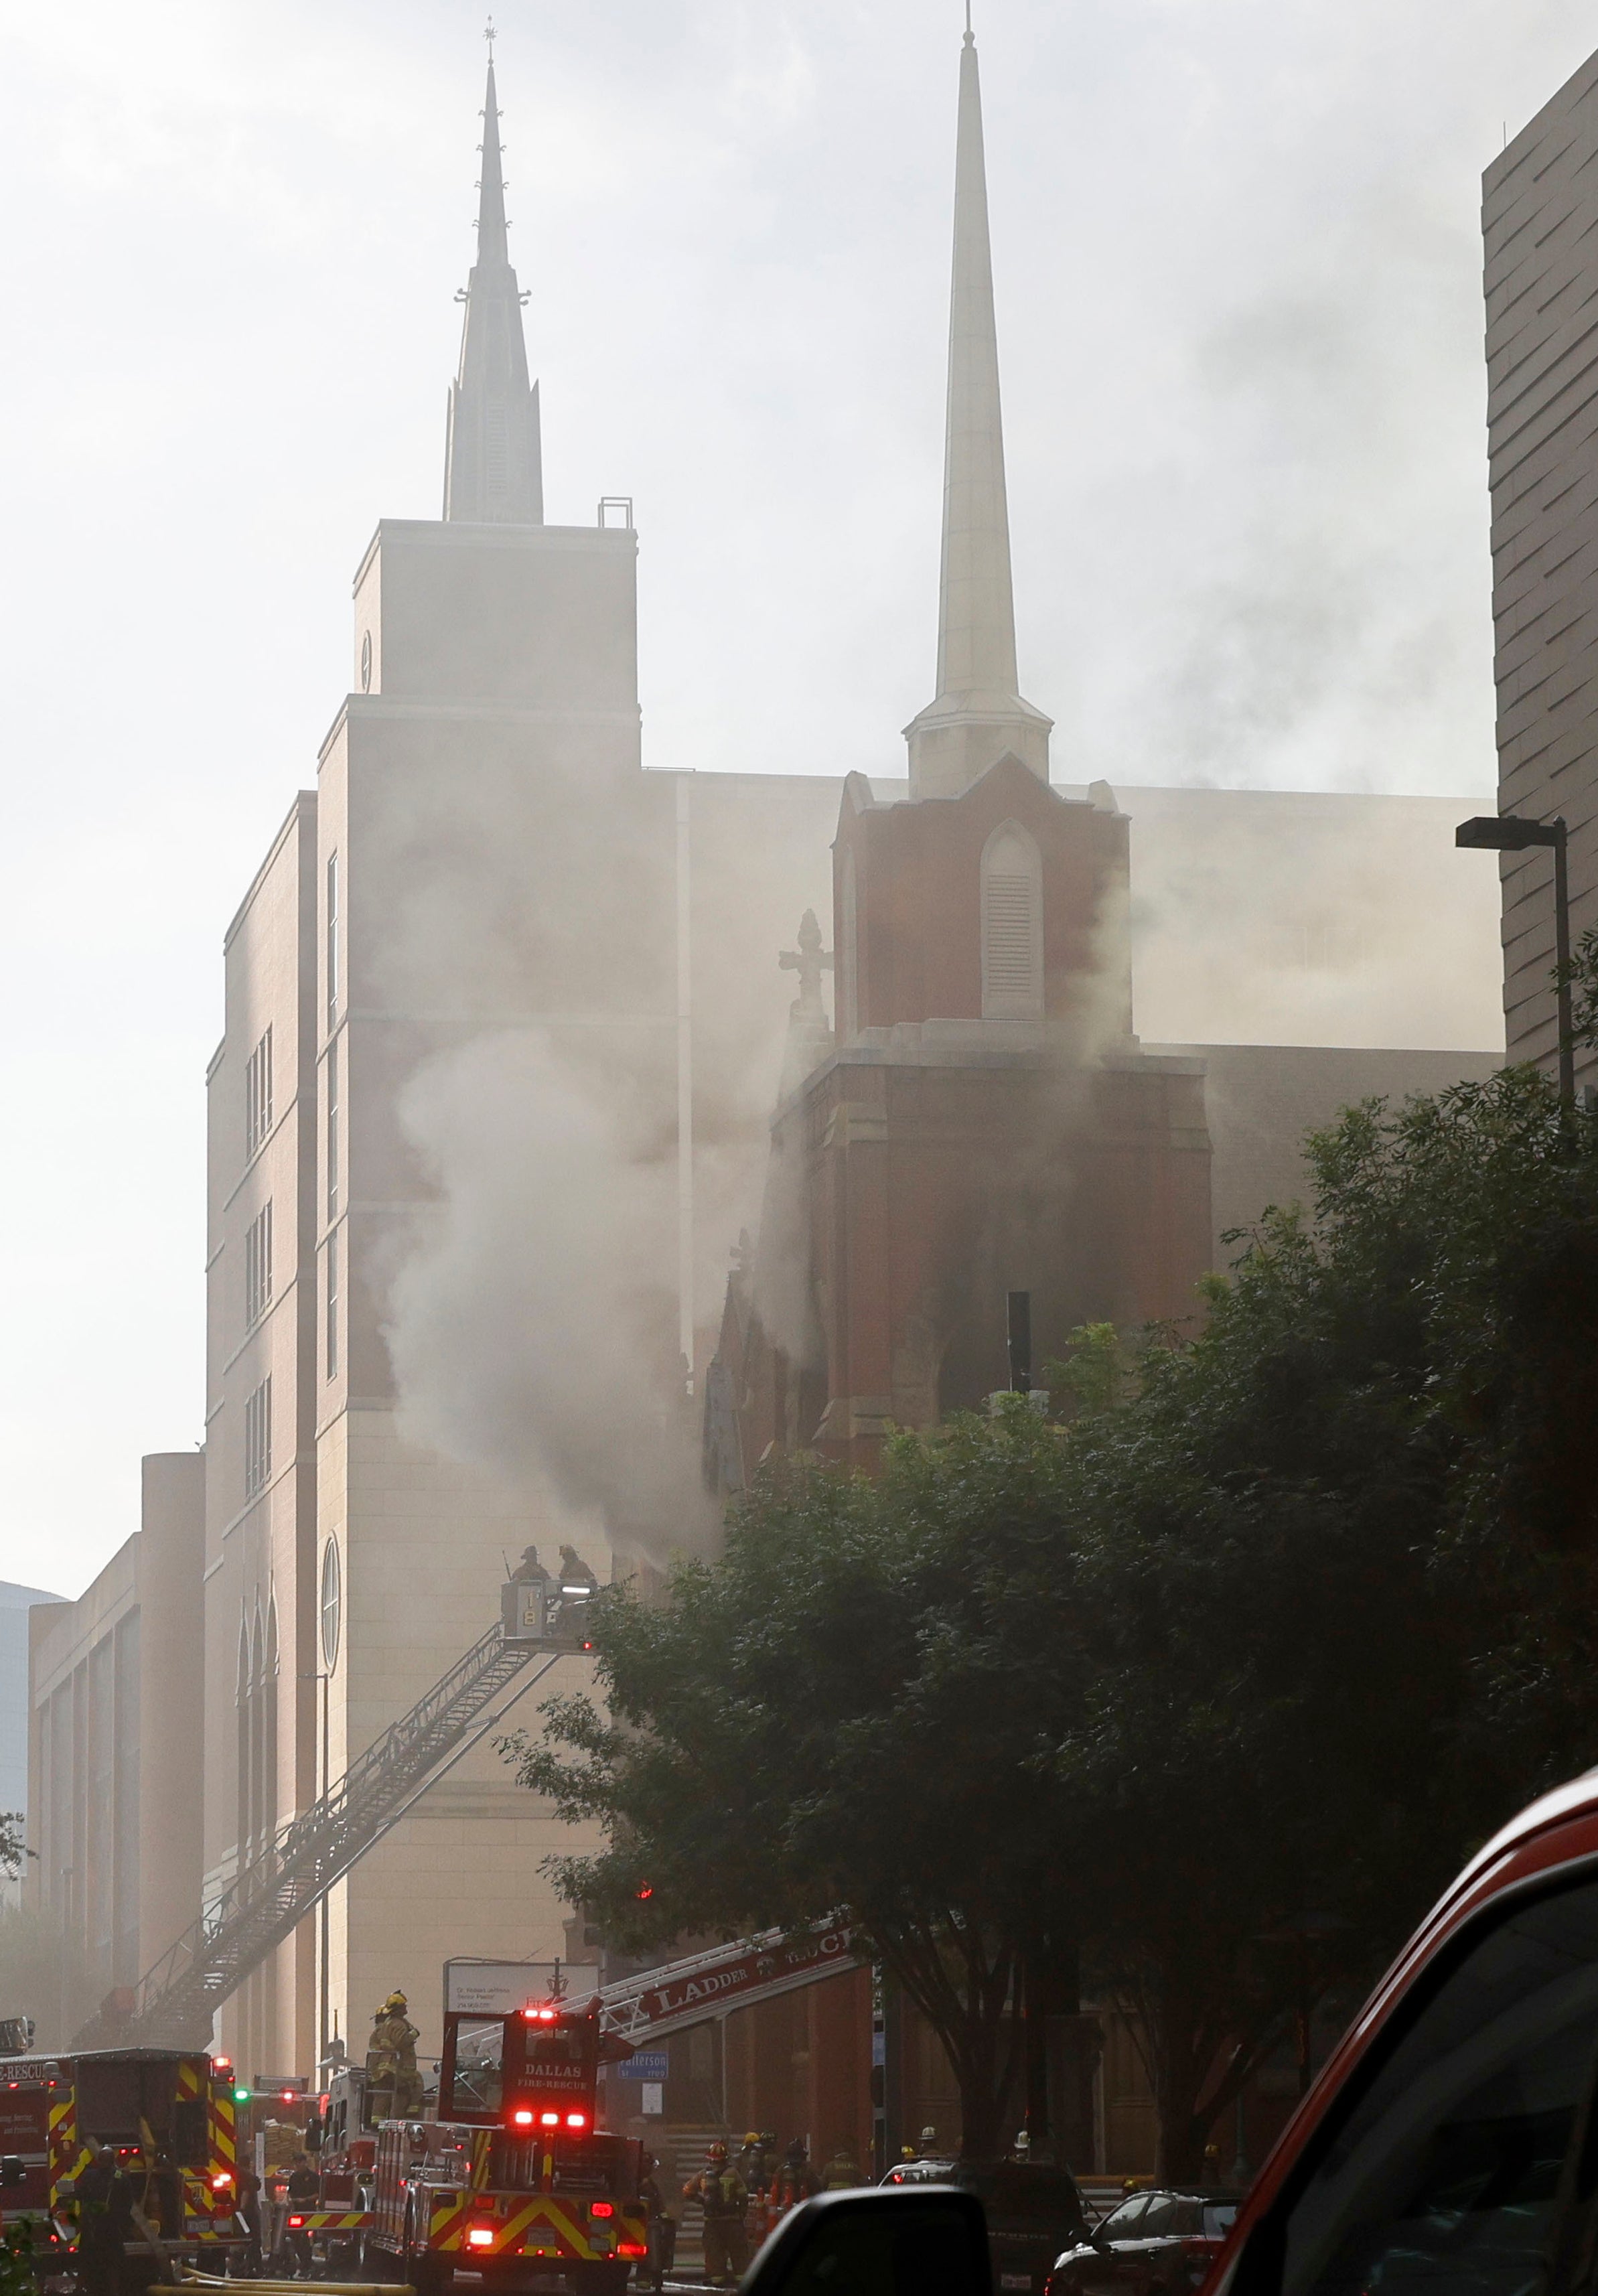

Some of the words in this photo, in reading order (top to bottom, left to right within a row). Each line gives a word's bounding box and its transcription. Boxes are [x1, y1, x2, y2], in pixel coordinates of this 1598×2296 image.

[653, 1968, 749, 2014] LADDER
[785, 1927, 857, 1964] TUC
[0, 2064, 44, 2081] E-RESCU
[525, 2064, 581, 2078] DALLAS
[518, 2078, 587, 2090] FIRE-RESCUE
